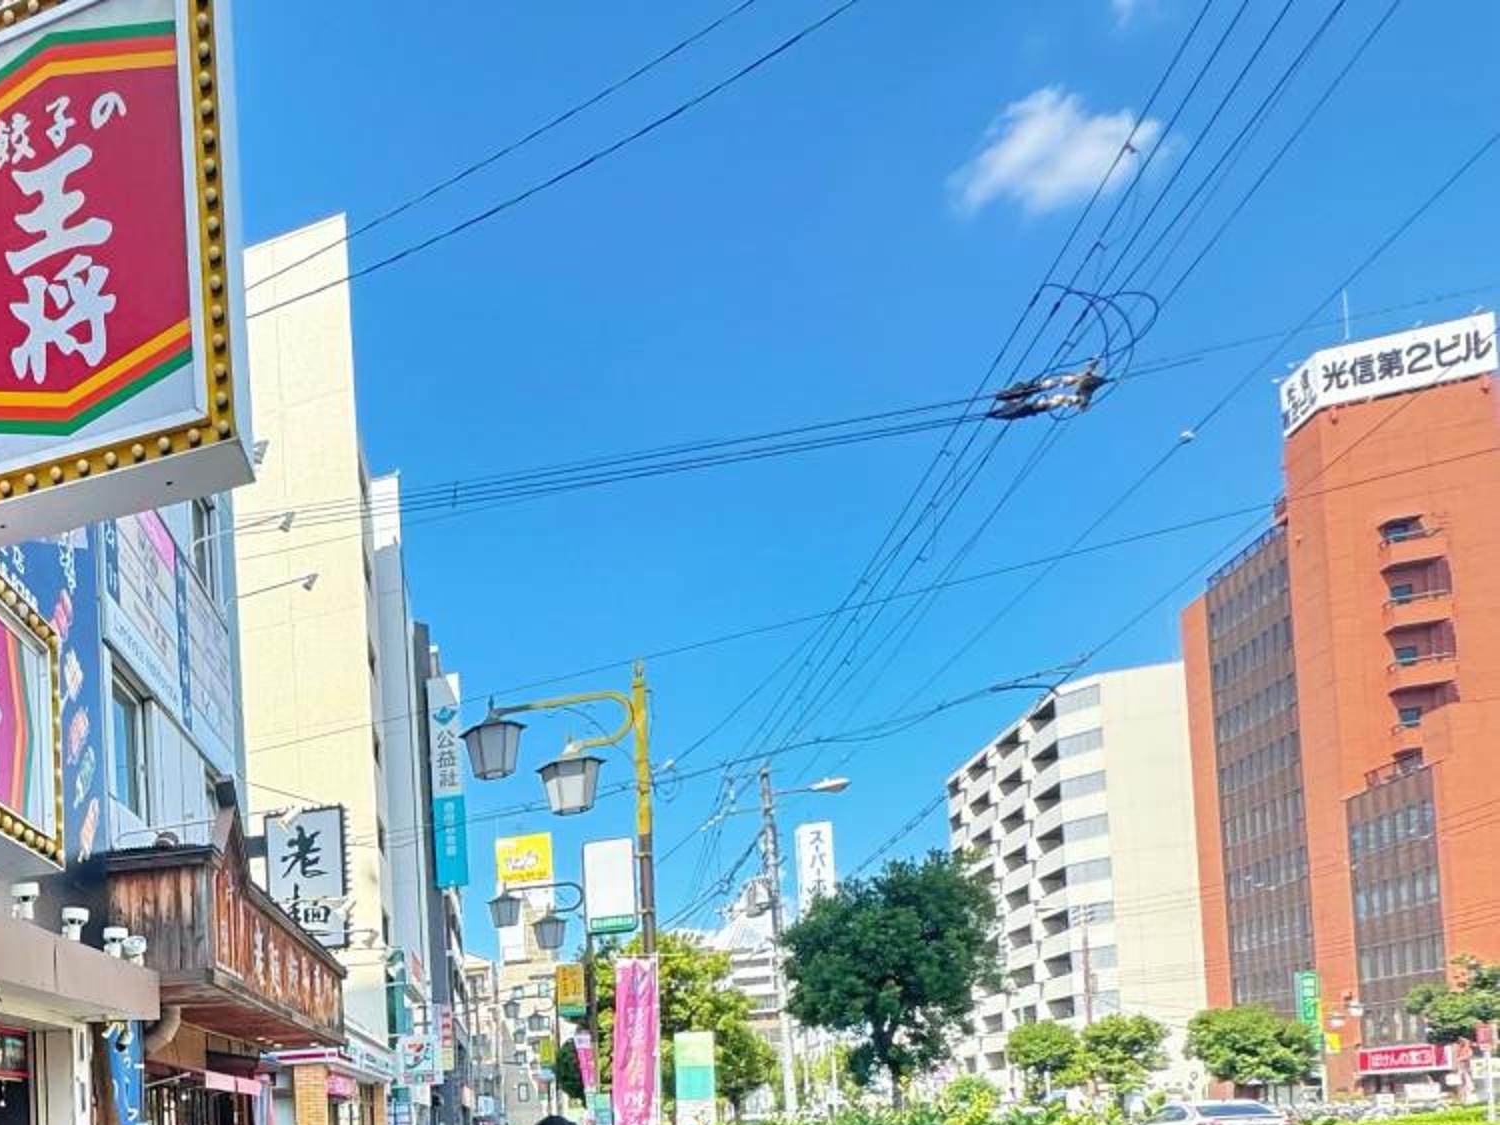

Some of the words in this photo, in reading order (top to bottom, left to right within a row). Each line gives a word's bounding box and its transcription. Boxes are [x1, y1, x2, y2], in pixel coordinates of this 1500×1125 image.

[4, 143, 117, 385] 王将
[1322, 330, 1493, 393] 光信第2ビル
[435, 729, 461, 788] 公益社
